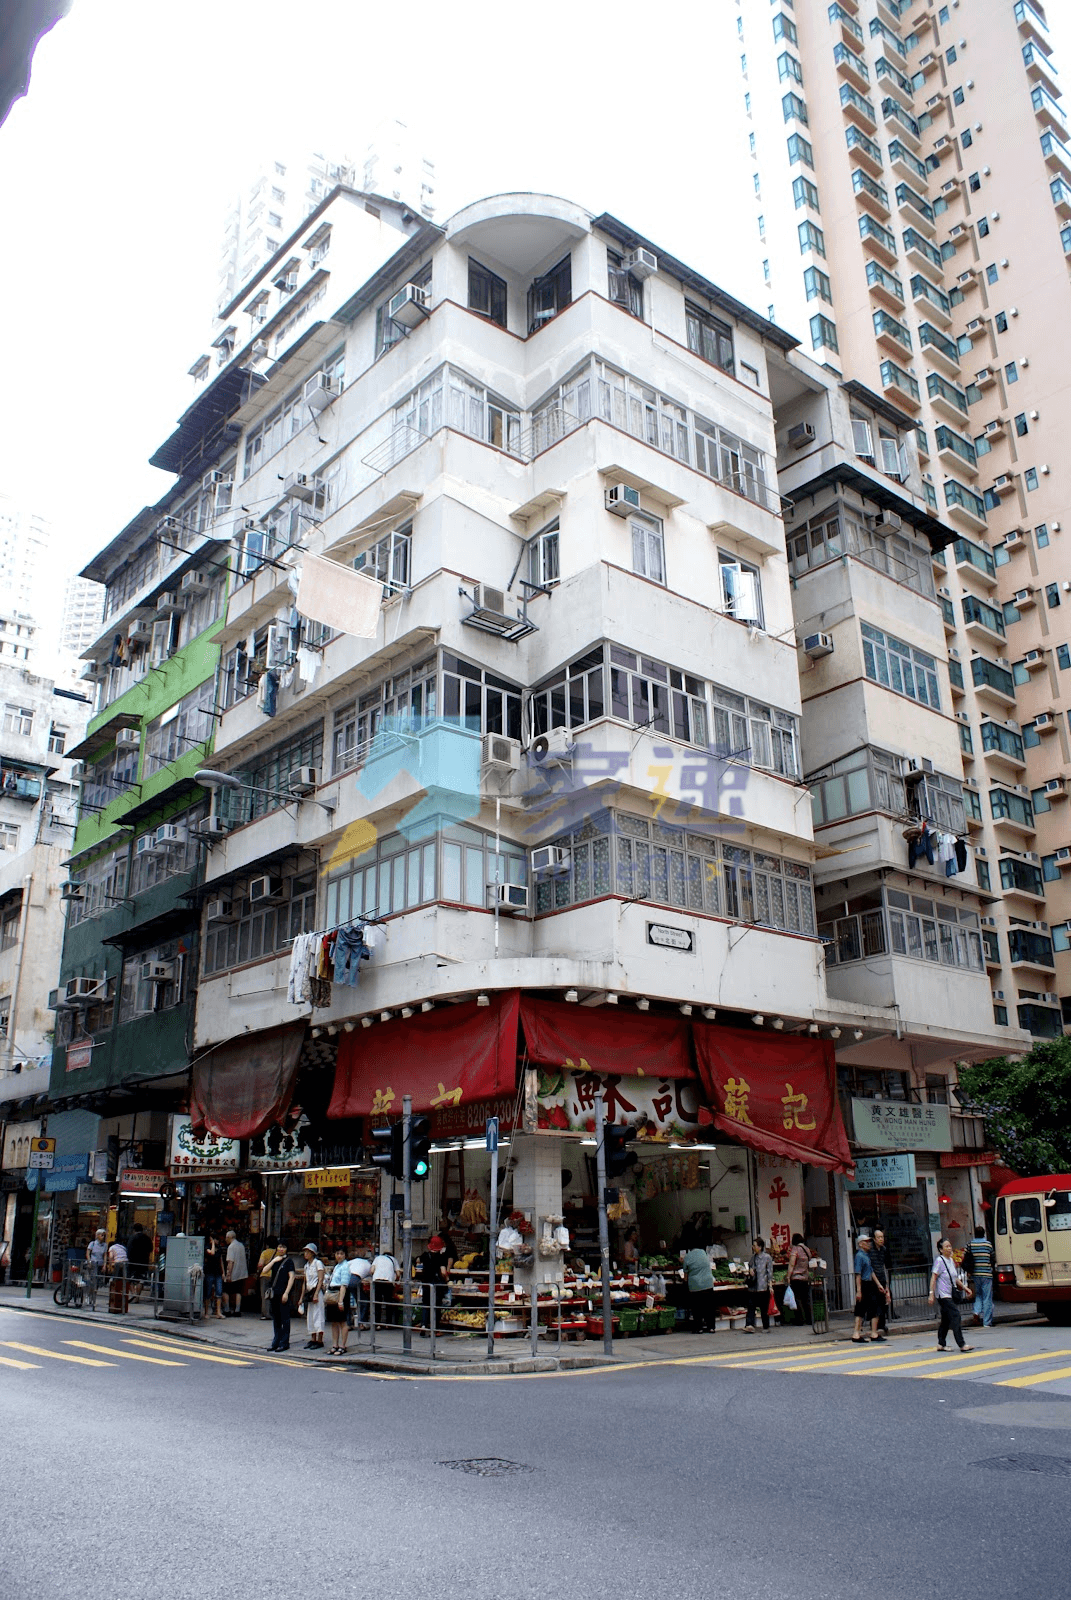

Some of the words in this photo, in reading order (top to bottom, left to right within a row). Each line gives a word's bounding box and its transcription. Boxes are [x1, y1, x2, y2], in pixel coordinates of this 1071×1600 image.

[871, 1105, 935, 1119] 黃文雄醫生
[884, 1117, 902, 1125] WONG
[919, 1119, 936, 1127] HUNG
[866, 1180, 881, 1188] 2819
[882, 1179, 896, 1187] 0167
